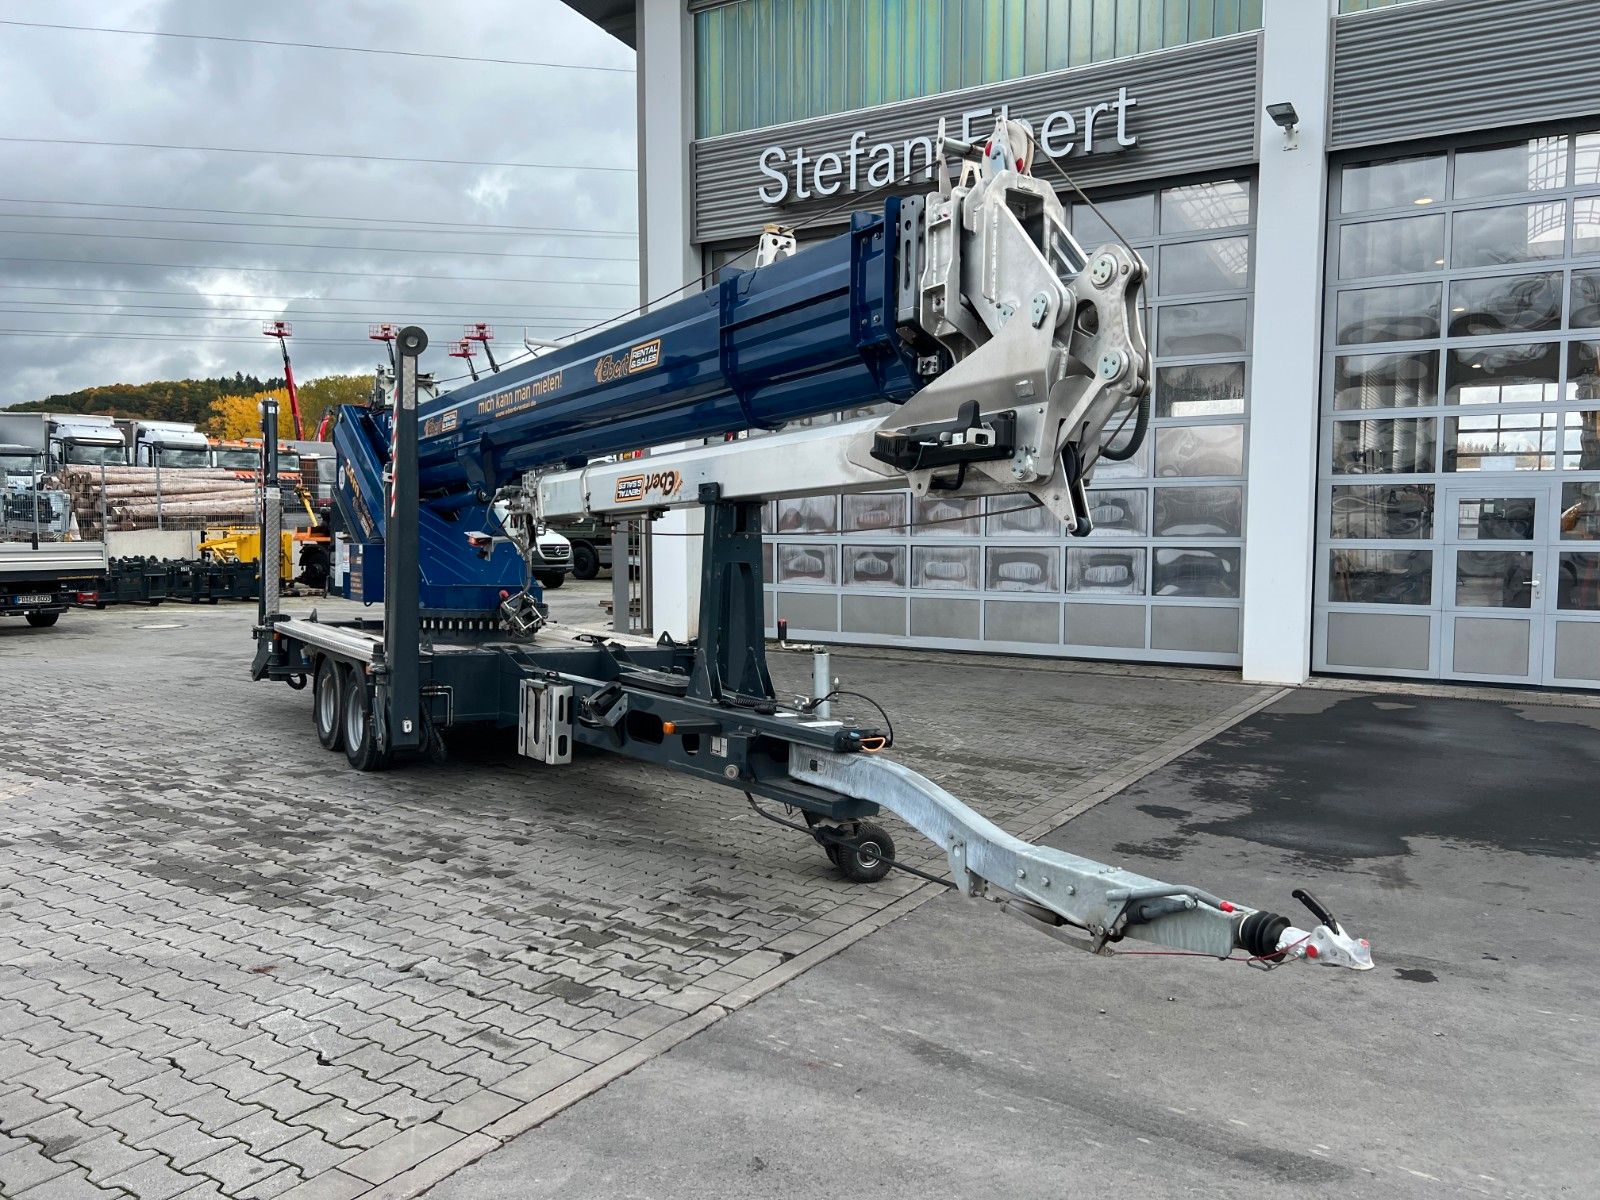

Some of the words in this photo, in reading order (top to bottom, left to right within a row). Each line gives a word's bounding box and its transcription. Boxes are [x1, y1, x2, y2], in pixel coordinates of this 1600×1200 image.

[758, 131, 933, 204] Stefan
[961, 87, 1138, 170] Eert
[632, 345, 658, 359] RENTAL
[478, 394, 495, 415] mich
[495, 391, 513, 409] kann
[514, 384, 532, 403] man
[532, 369, 563, 397] mieten!
[618, 488, 641, 498] RENTAL
[645, 471, 682, 496] Ebert
